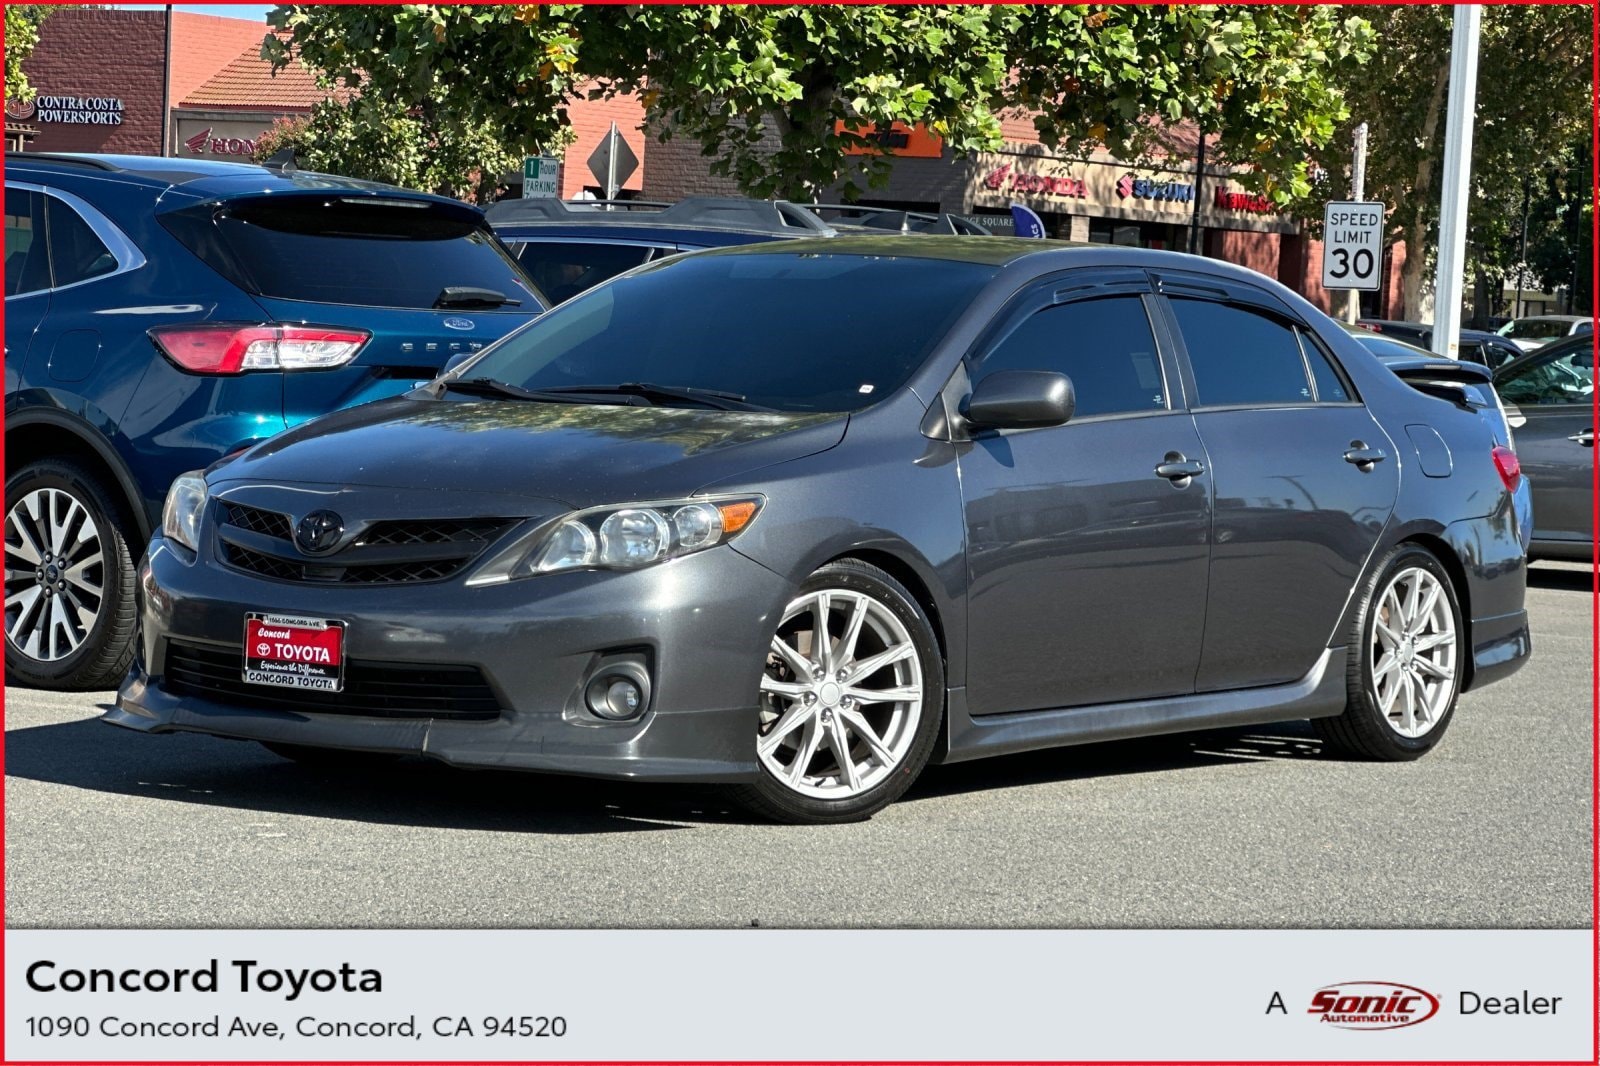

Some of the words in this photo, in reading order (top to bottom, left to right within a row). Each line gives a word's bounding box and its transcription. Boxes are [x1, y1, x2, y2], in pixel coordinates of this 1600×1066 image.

[37, 95, 84, 110] CONTRA
[85, 97, 123, 111] COSTA
[37, 109, 121, 125] POWERSPORTS
[210, 138, 256, 155] HON
[530, 160, 534, 176] 1
[540, 162, 557, 175] HOUR
[525, 180, 556, 193] PARKING
[1009, 172, 1089, 197] HONDA
[1133, 179, 1195, 201] SUZUKI
[982, 217, 1015, 227] SQUARE
[1330, 212, 1379, 226] SPEED
[1334, 230, 1372, 244] LIMIT
[1329, 248, 1375, 279] 30
[401, 341, 483, 353] ESCA
[282, 618, 308, 626] CONCORD
[258, 627, 290, 639] Concord
[274, 643, 331, 662] TOYOTA
[260, 660, 288, 671] Experience
[288, 662, 297, 671] the
[249, 672, 295, 685] CONCORD
[297, 678, 334, 689] TOYOTA
